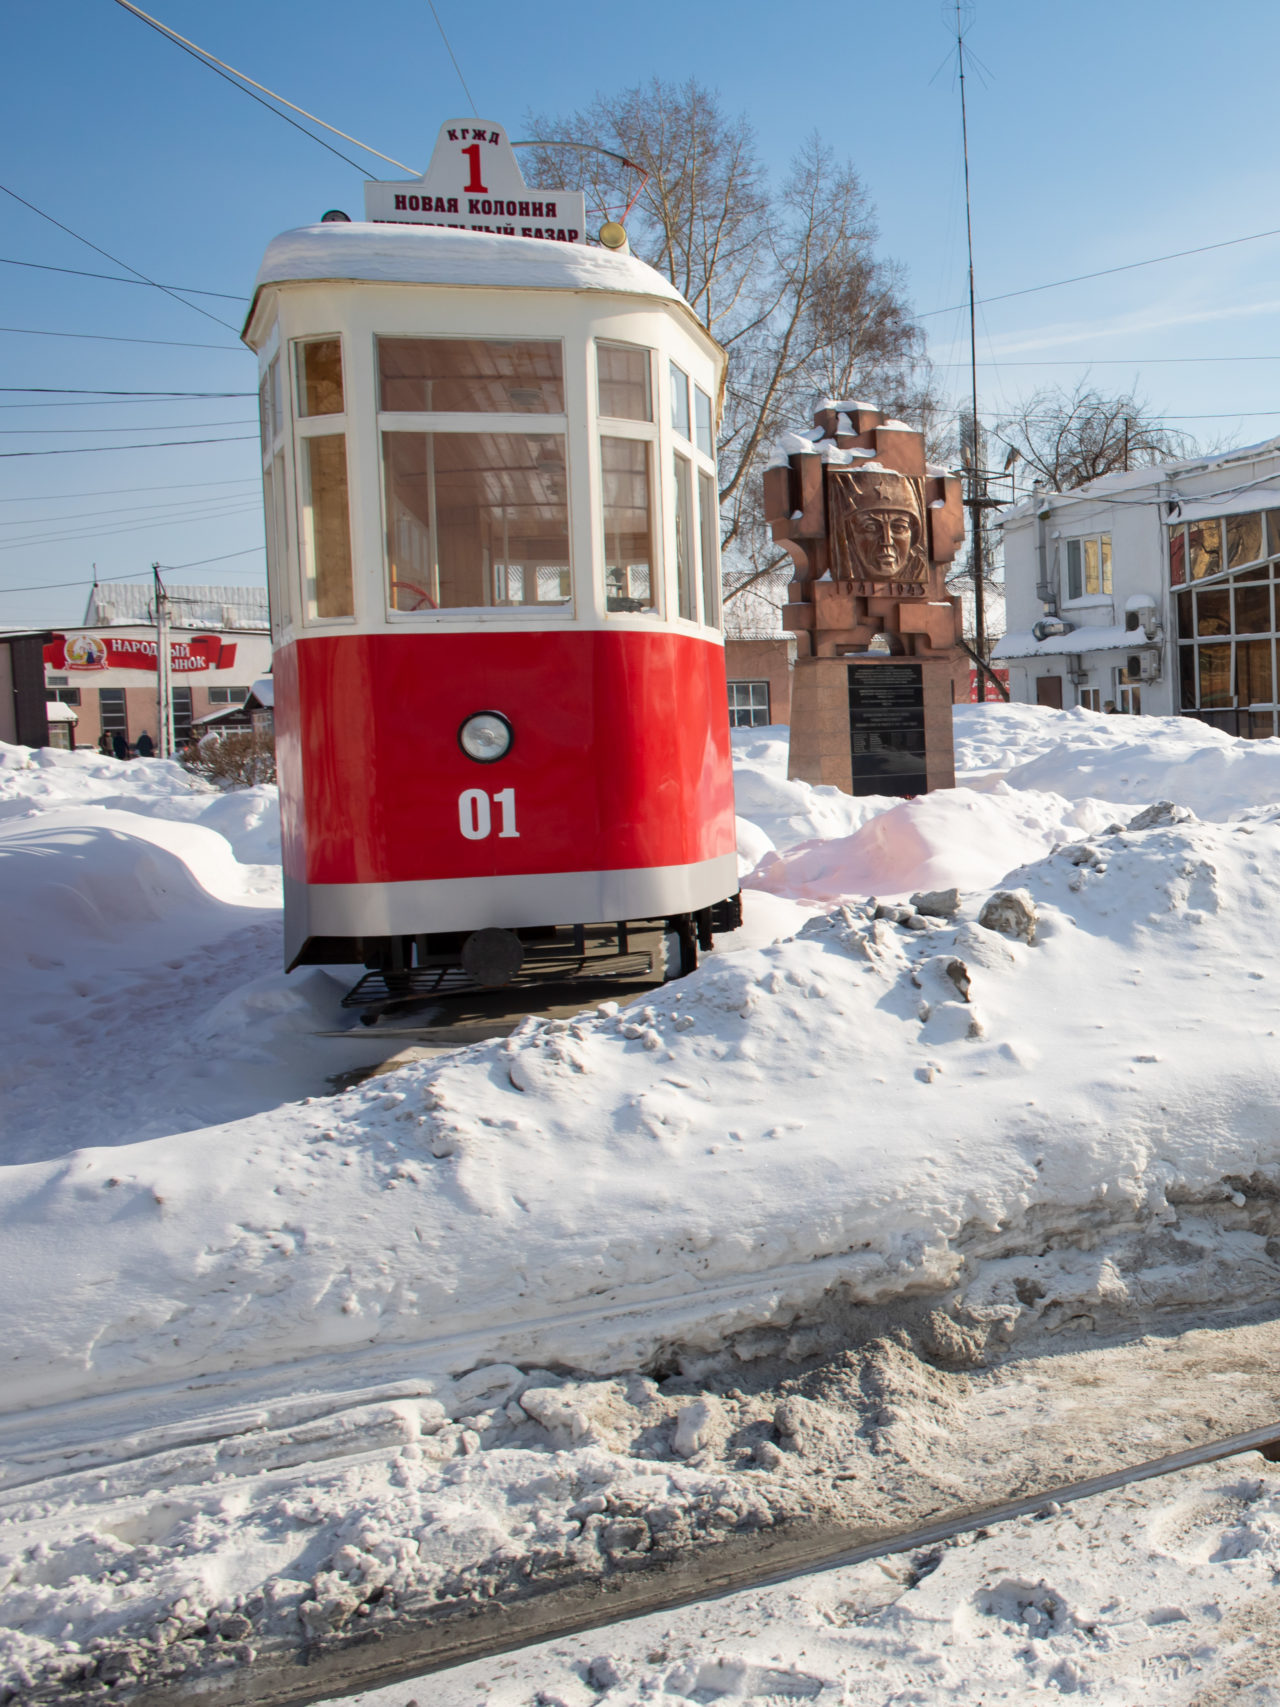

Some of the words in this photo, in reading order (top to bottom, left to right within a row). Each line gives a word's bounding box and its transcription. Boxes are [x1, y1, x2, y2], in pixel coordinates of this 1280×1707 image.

[447, 128, 500, 146] КГЖД
[461, 143, 488, 194] 1
[394, 194, 459, 214] НОВАЯ
[521, 227, 579, 243] БАЗАР
[111, 639, 190, 657] НАРОДЫЙ
[169, 656, 206, 670] ЫНОК
[458, 788, 520, 840] 01
